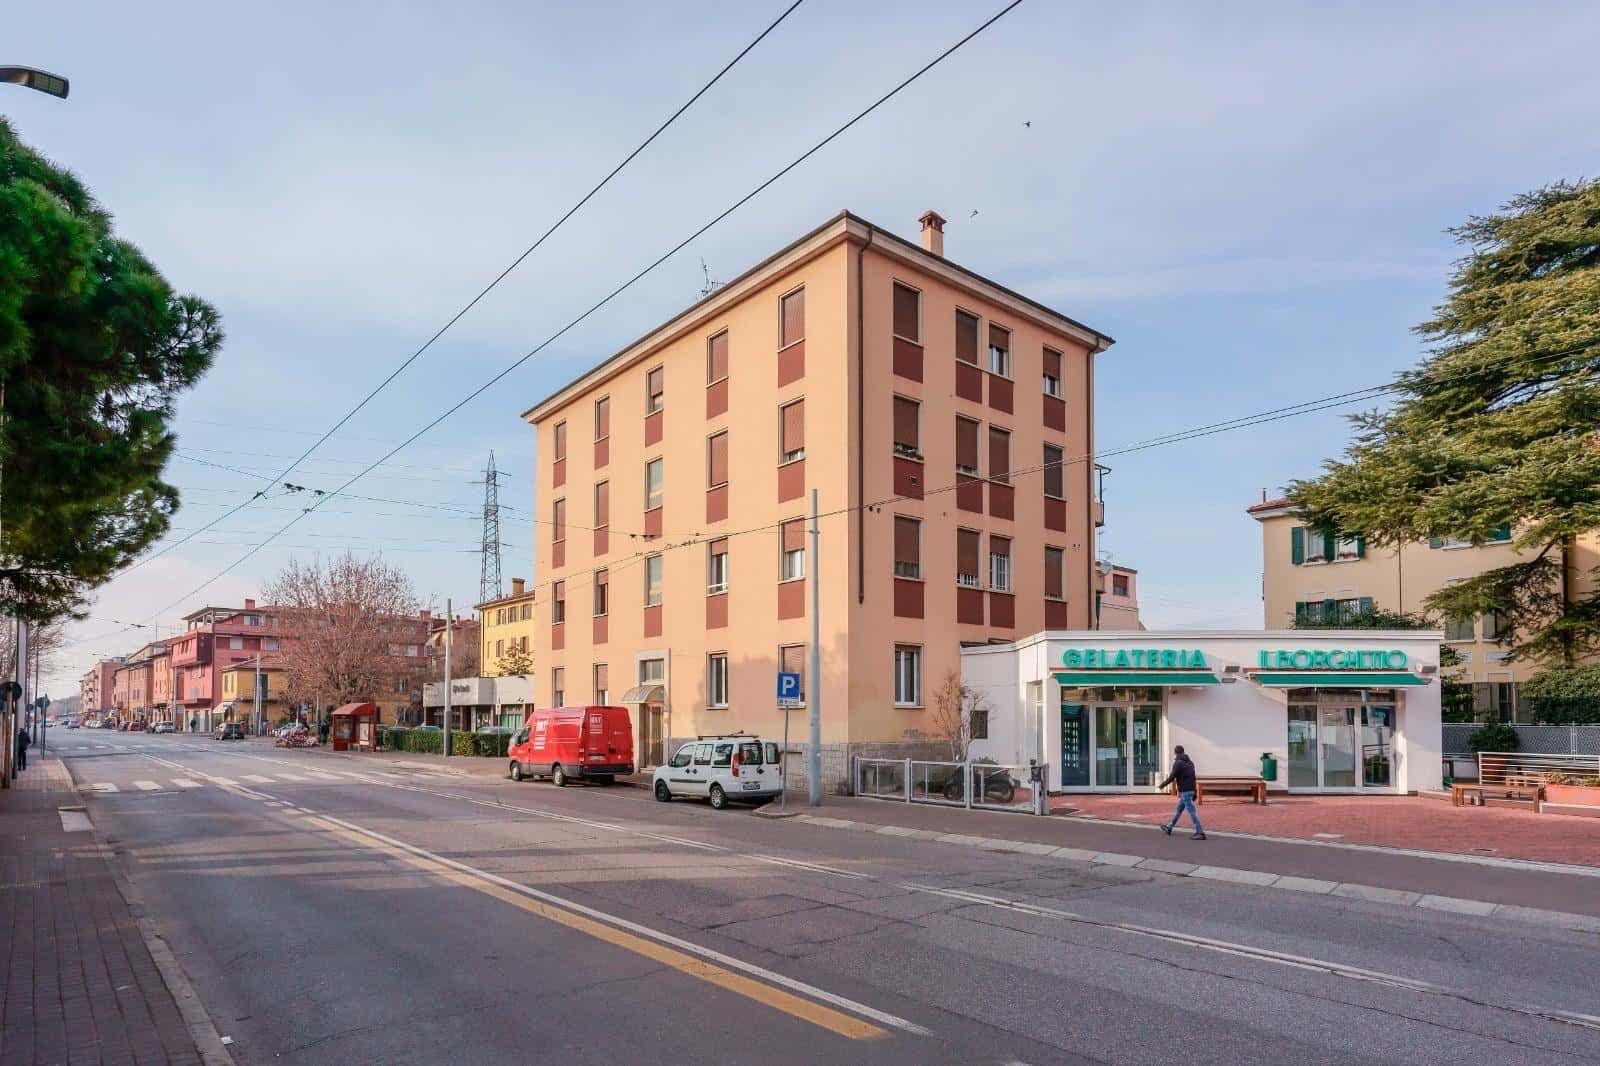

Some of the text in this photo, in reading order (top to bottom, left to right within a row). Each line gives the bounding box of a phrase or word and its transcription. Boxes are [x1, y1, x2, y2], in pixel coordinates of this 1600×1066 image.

[1062, 648, 1207, 668] GELATERIA
[1274, 649, 1407, 668] BORGHETTO
[782, 676, 795, 695] P
